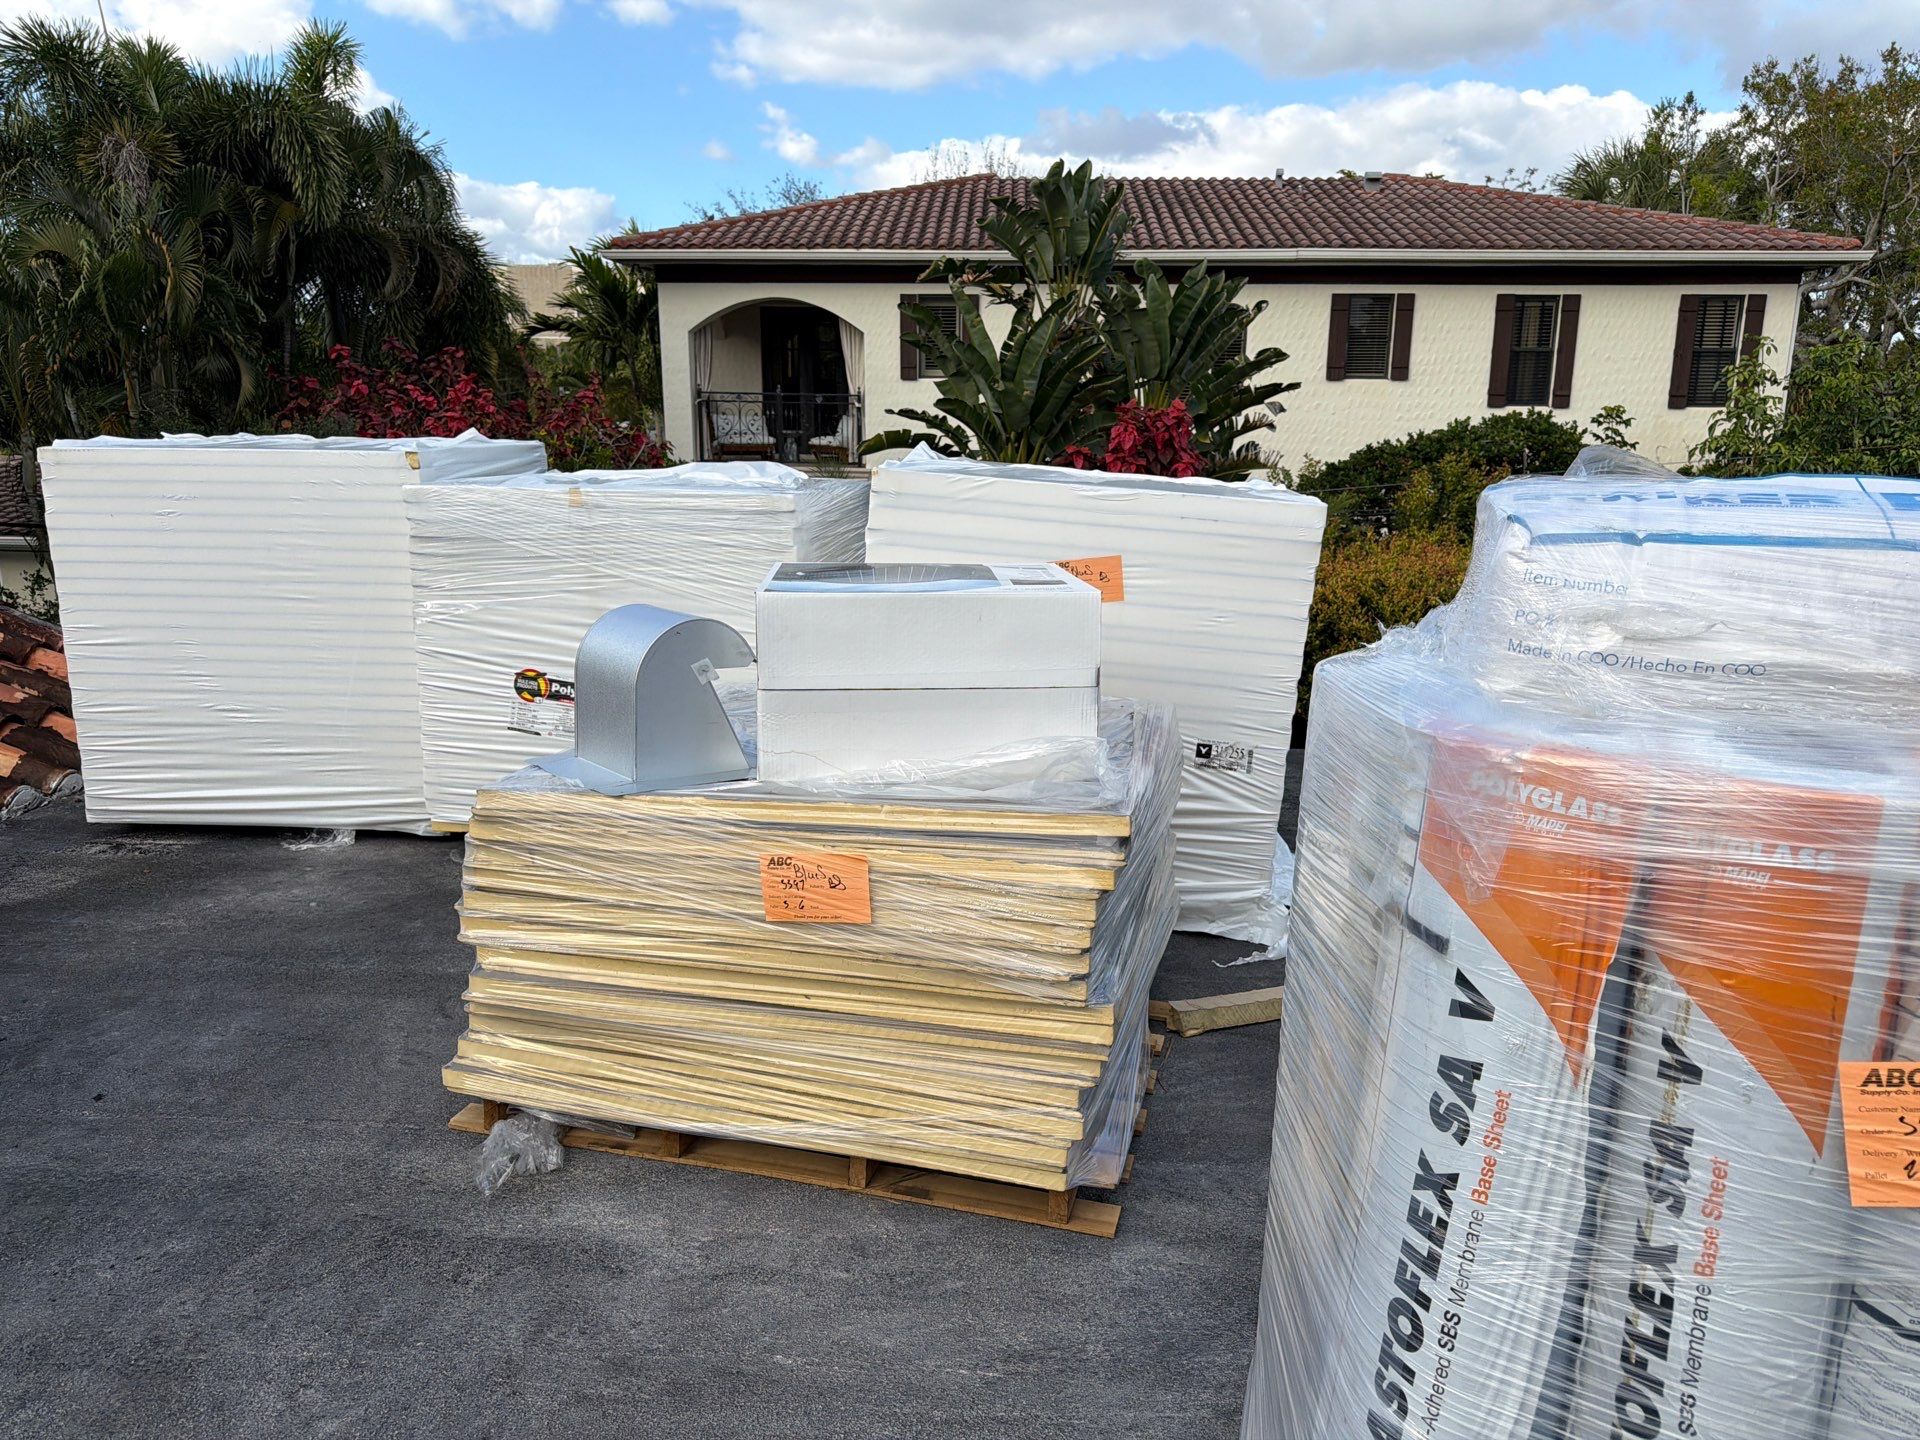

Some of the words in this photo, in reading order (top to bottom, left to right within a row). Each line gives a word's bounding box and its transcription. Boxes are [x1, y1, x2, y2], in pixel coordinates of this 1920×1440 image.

[1507, 638, 1553, 658] Made
[1722, 663, 1767, 677] COO
[767, 856, 793, 867] ABC
[1448, 967, 1495, 1022] V
[1657, 1027, 1703, 1085] V
[1429, 1054, 1484, 1147] SA
[1482, 1089, 1512, 1150] Sheet
[1471, 1154, 1497, 1206] Base
[1862, 1149, 1898, 1158] Delivery
[1701, 1155, 1730, 1221] Sheet
[1447, 1208, 1485, 1308] Membrane
[1693, 1225, 1720, 1280] Base
[1437, 1308, 1462, 1353] SBS
[1680, 1283, 1712, 1390] Membrane
